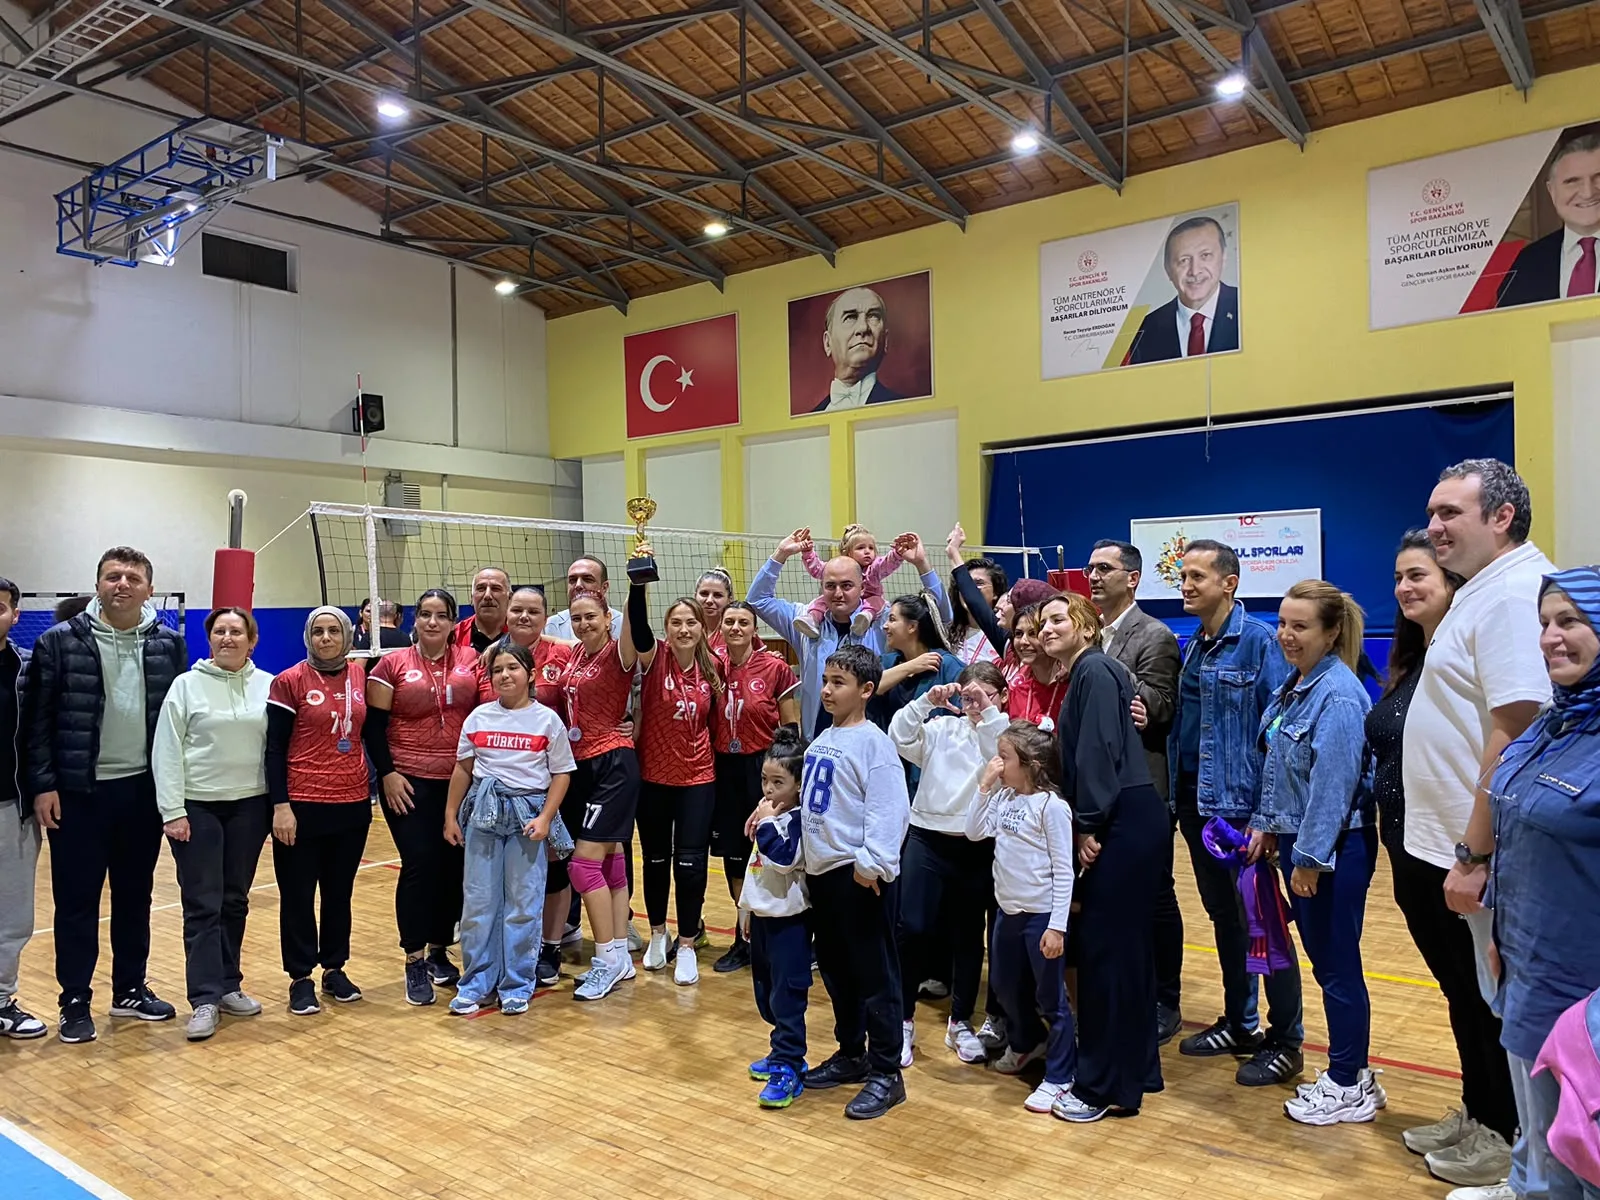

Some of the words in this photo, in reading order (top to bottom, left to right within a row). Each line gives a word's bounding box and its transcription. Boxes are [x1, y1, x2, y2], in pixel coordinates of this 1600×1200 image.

[1410, 216, 1427, 224] SPOR
[1428, 209, 1464, 219] BAKANLIĞI
[1386, 233, 1411, 246] TÜM
[1413, 222, 1473, 240] ANTRENÖR
[1476, 217, 1490, 228] VE
[1384, 251, 1436, 264] BAŞARILAR
[1439, 240, 1493, 255] DİLİYORUM
[1390, 230, 1487, 255] SPORCULARIMIZA
[1456, 263, 1470, 271] BAK
[1052, 295, 1070, 306] TÜM
[1071, 288, 1114, 302] ANTRENÖR
[1115, 285, 1126, 294] VE
[1054, 295, 1124, 314] SPORCULARIMIZA
[1050, 311, 1087, 322] BAŞARILAR
[1089, 304, 1128, 315] DİLİYORUM
[1251, 545, 1304, 558] SPORLARI
[486, 732, 532, 750] TÜRKİYE
[801, 754, 835, 816] 78
[582, 802, 603, 830] 17
